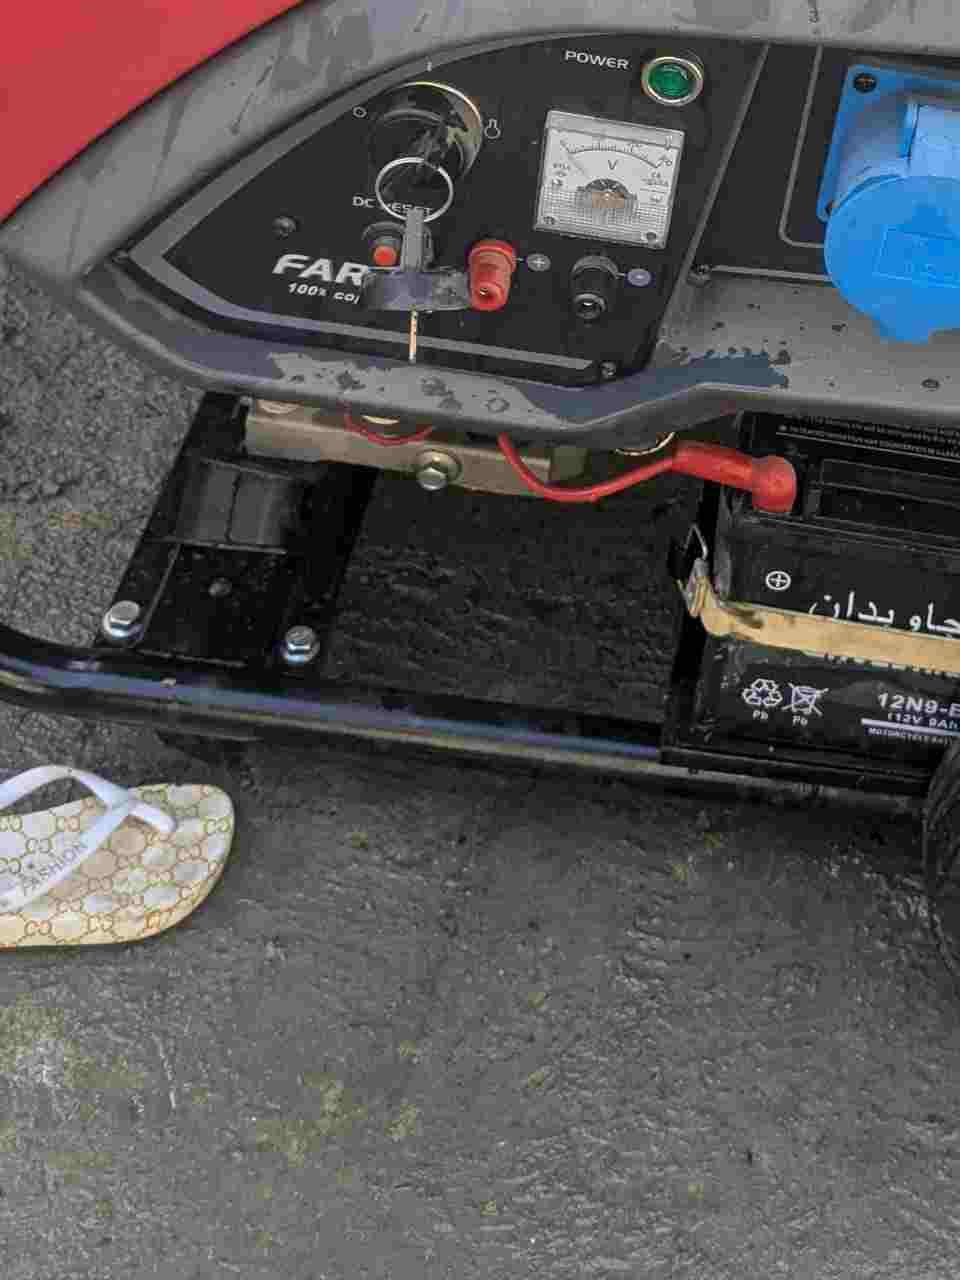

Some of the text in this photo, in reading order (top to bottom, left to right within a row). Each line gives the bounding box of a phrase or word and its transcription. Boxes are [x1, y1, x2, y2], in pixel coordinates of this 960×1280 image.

[564, 50, 630, 70] POWER
[352, 196, 376, 208] DC
[288, 282, 327, 297] 100%
